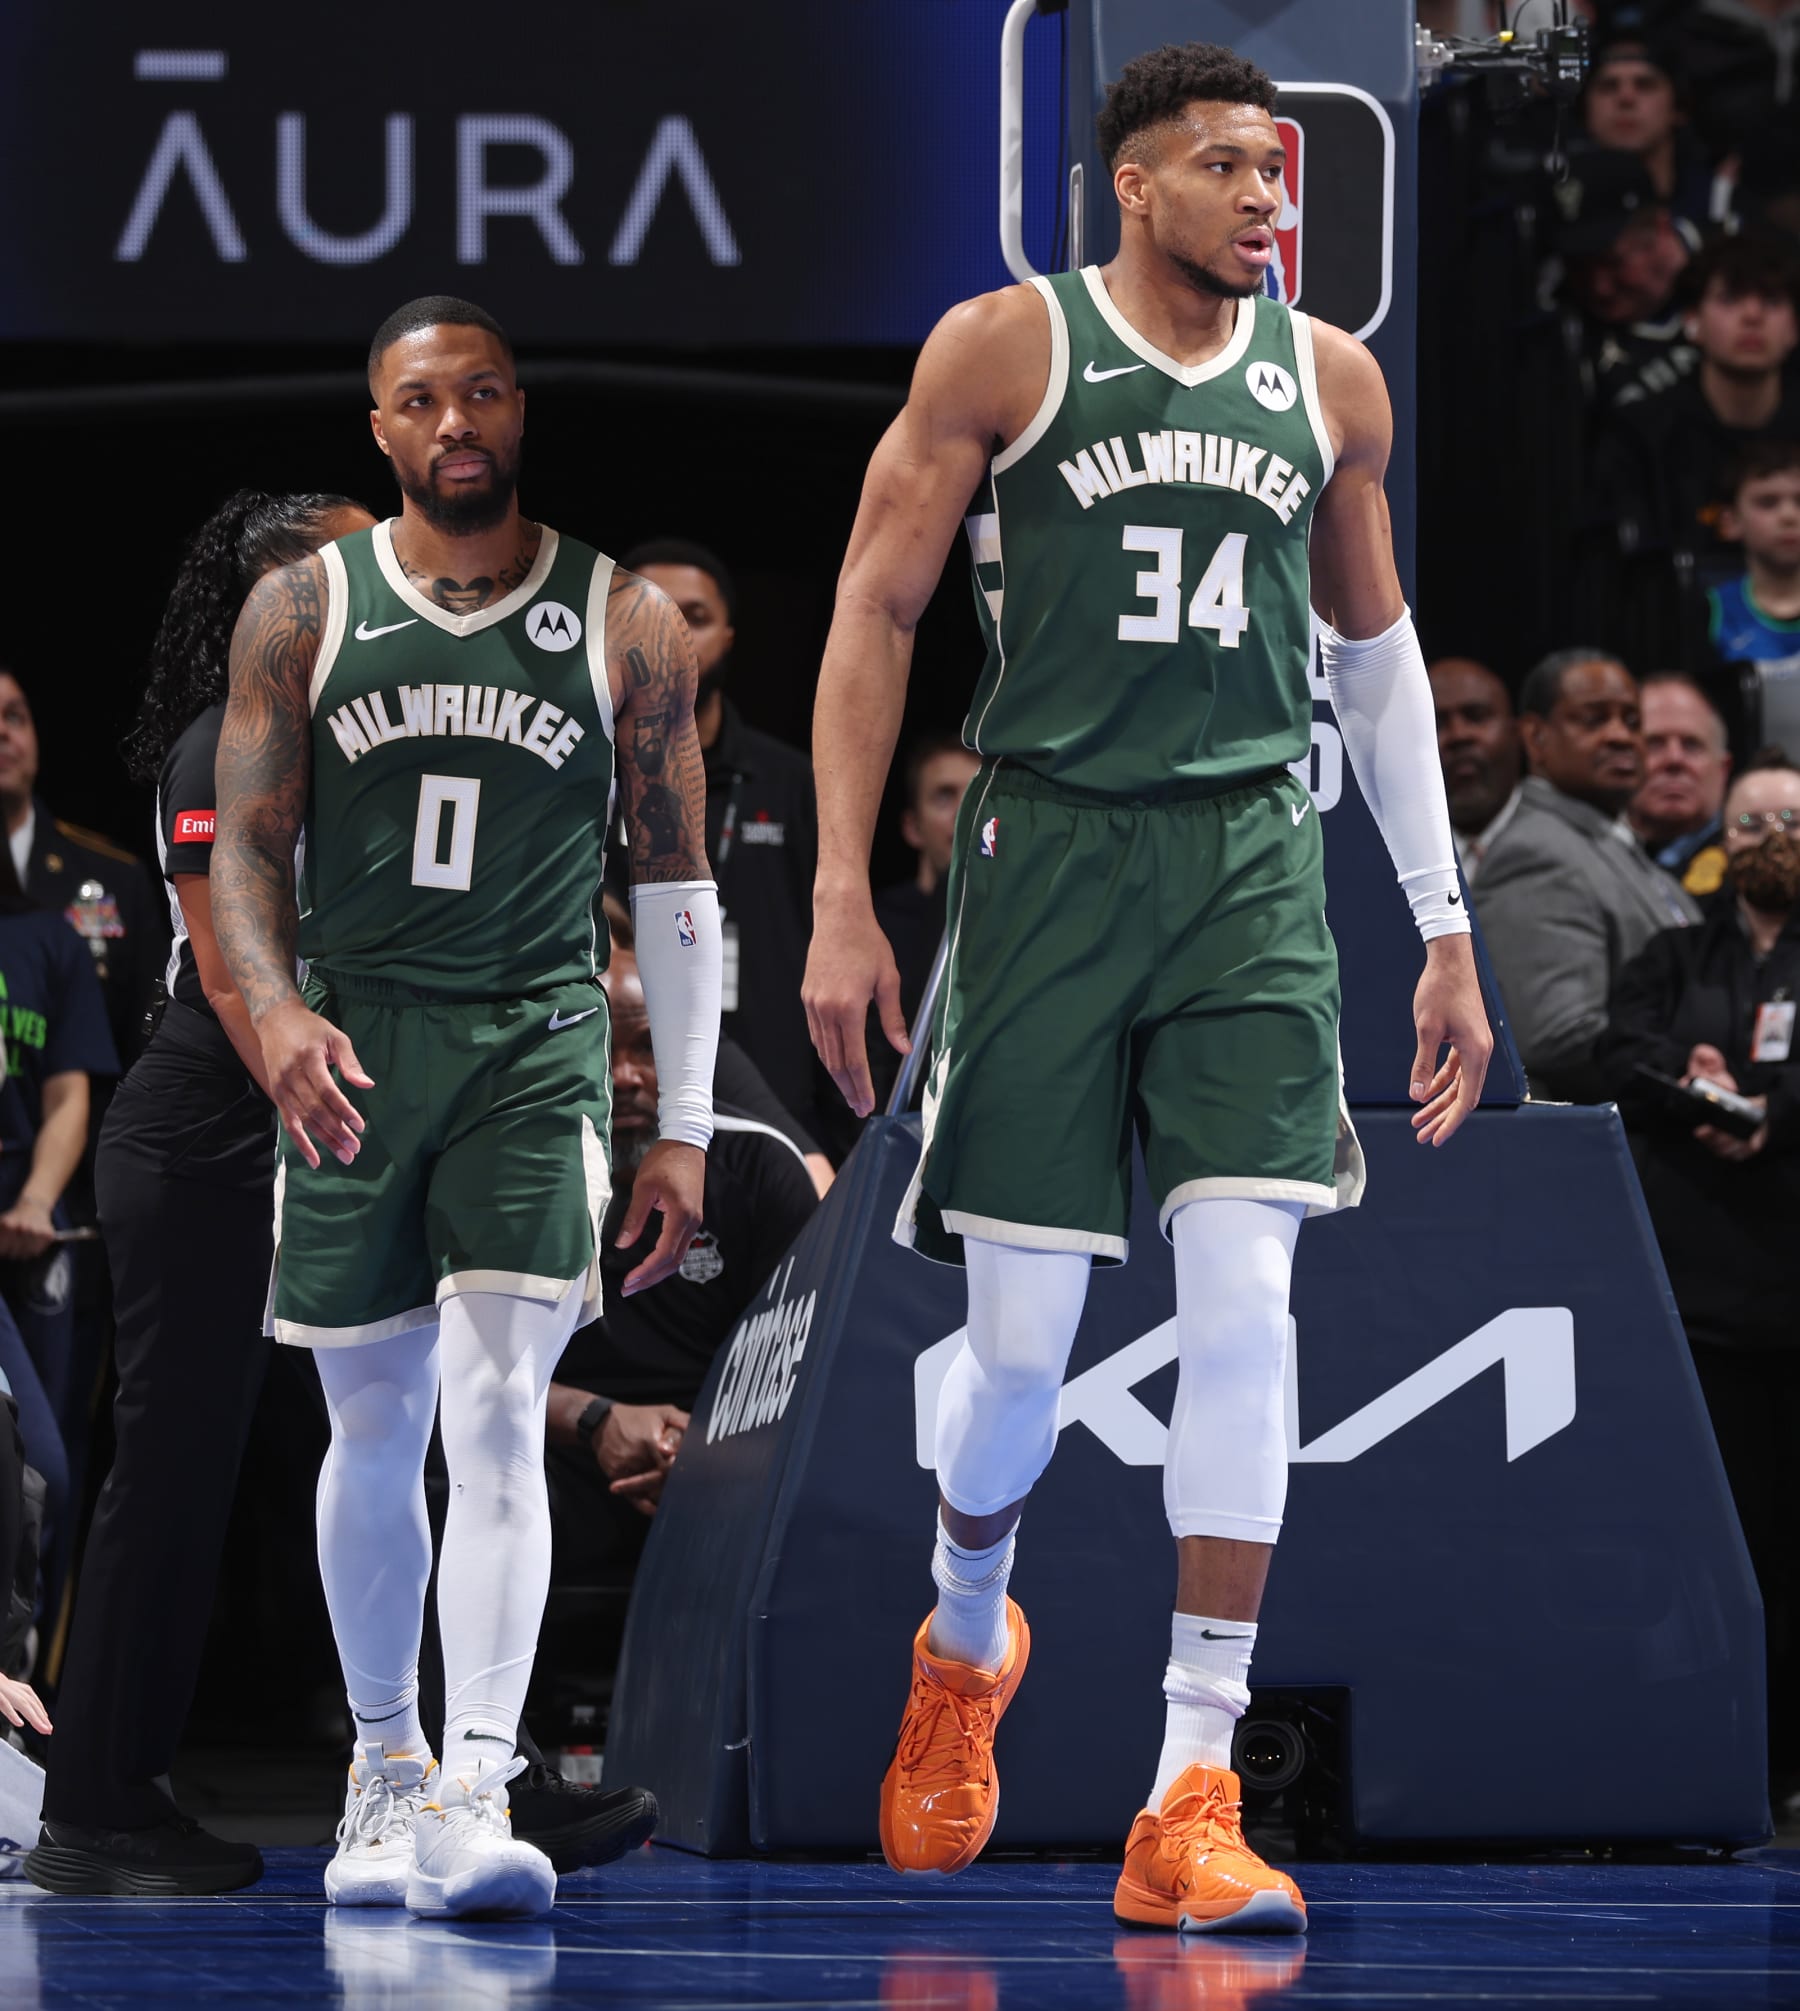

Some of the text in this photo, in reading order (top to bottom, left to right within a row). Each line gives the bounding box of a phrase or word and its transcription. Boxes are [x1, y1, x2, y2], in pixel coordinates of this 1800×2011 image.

[1057, 430, 1311, 526] MILWAUKEE
[1118, 525, 1250, 649] 34
[327, 684, 585, 771] MILWAUKEE
[411, 774, 481, 891] 0
[914, 1307, 1576, 1469] KA
